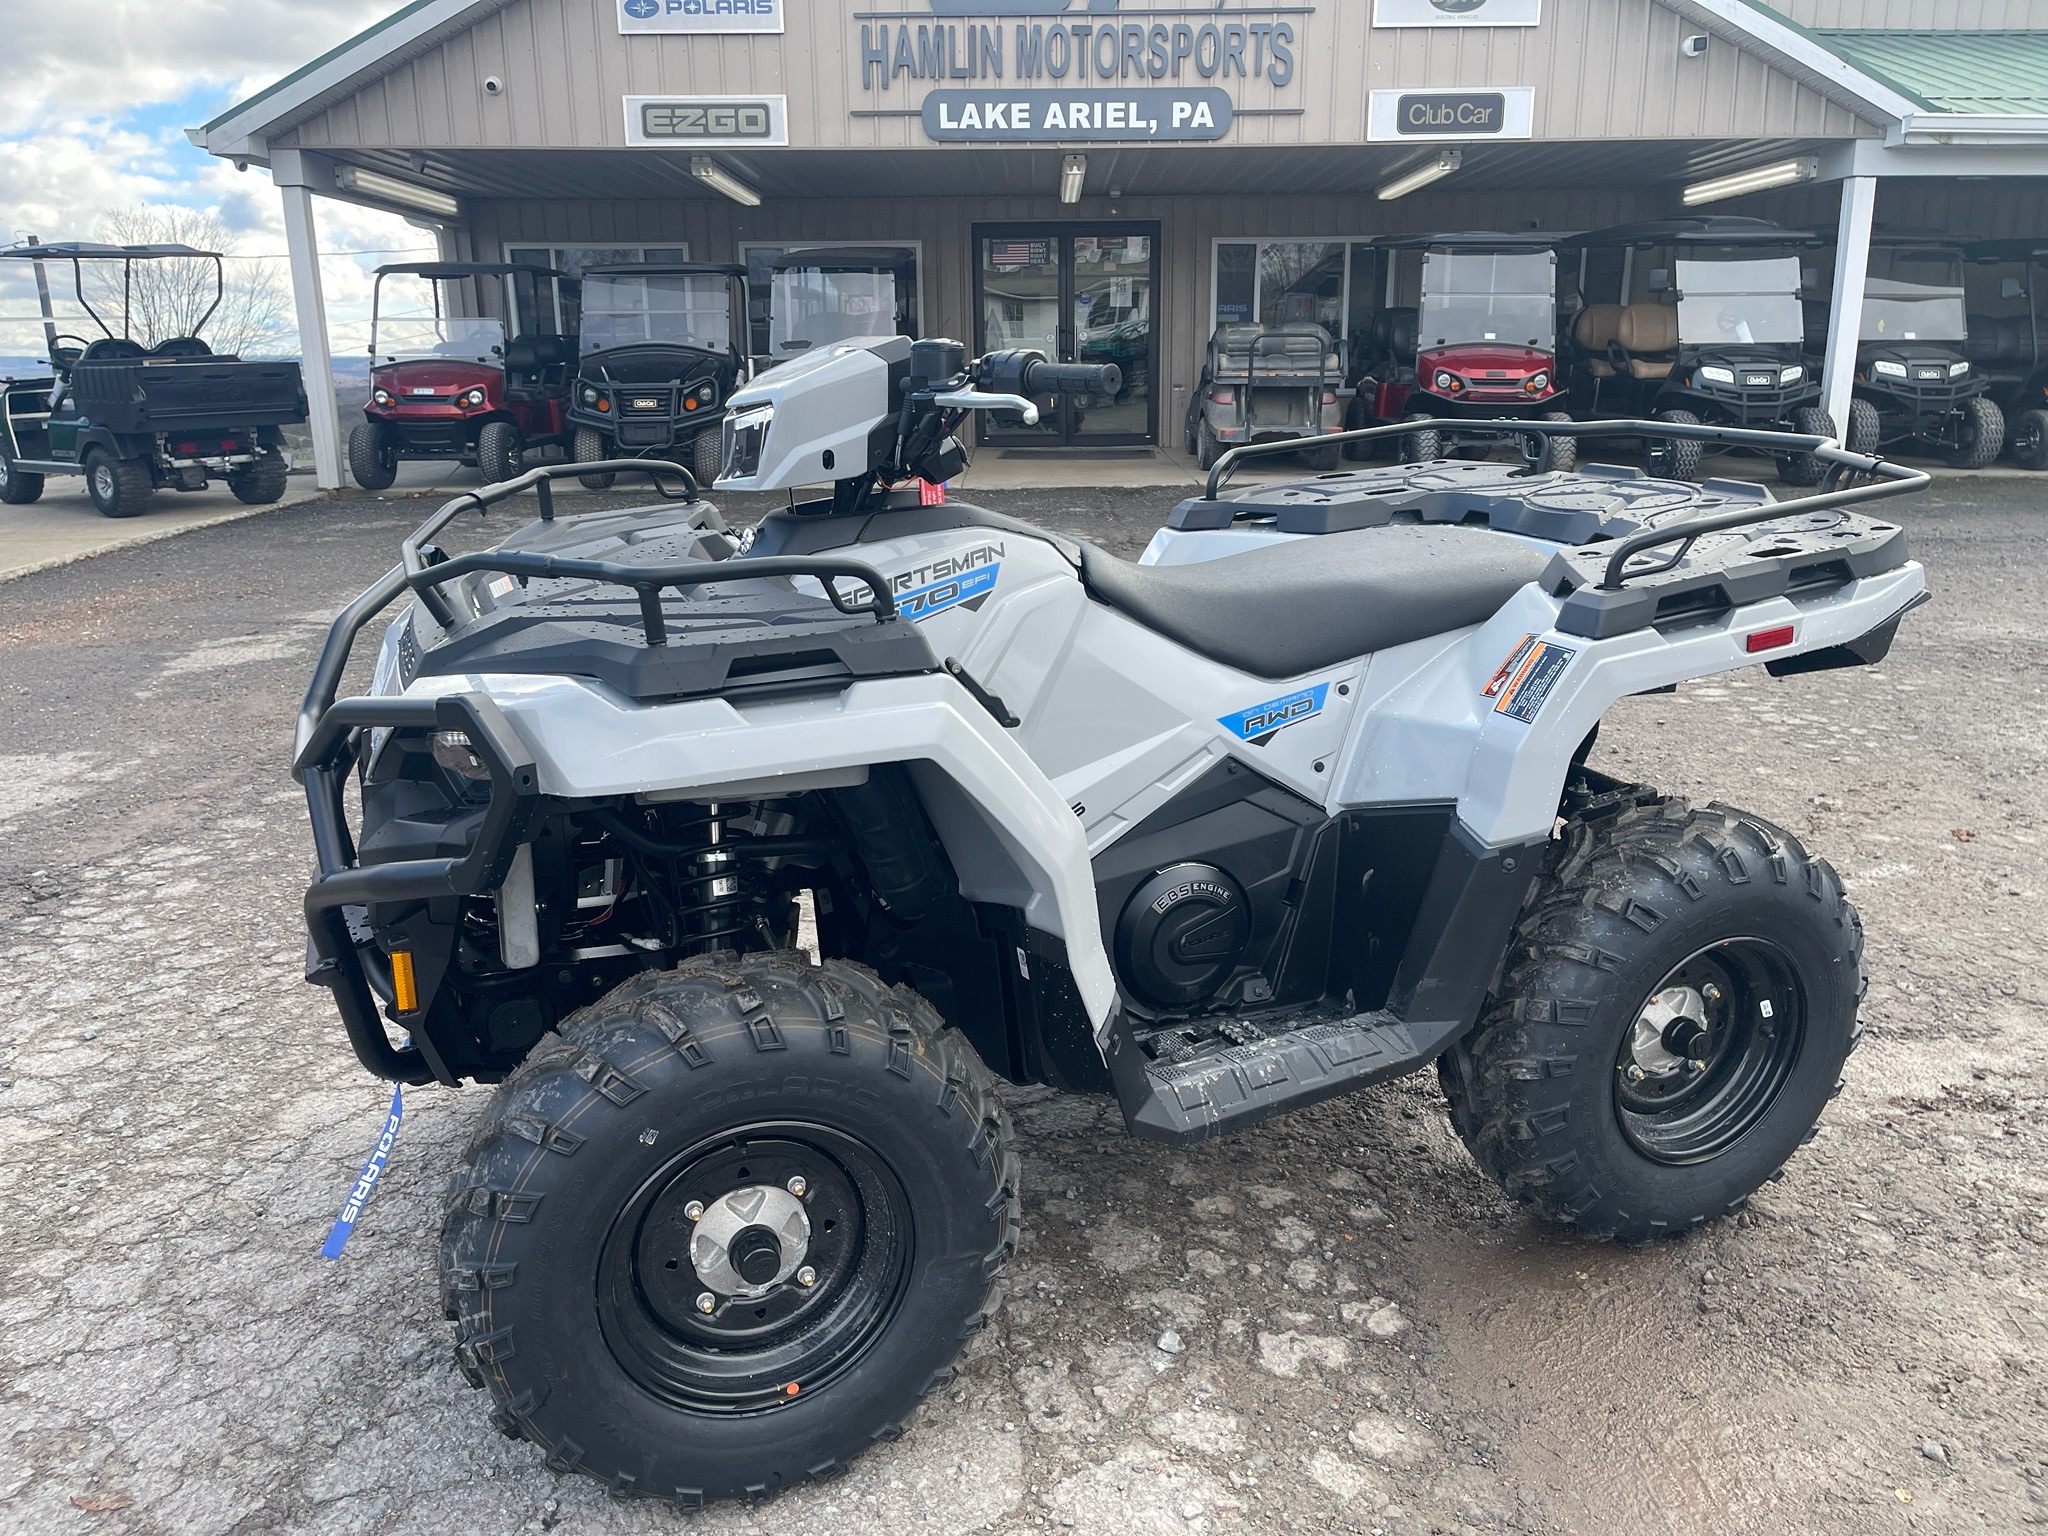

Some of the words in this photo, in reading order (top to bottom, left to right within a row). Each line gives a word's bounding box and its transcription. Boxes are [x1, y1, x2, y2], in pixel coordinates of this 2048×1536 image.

[666, 0, 774, 15] POLARIS
[861, 24, 1003, 90] HAMLIN
[1016, 21, 1295, 87] MOTORSPORTS
[939, 102, 1031, 130] LAKE
[1043, 101, 1158, 135] ARIEL,
[1172, 101, 1216, 129] PA
[1408, 103, 1454, 125] Club
[1456, 102, 1493, 124] Car
[1217, 304, 1248, 312] ARIS
[839, 542, 1006, 605] SPRTSMAN
[962, 573, 990, 590] EFI
[1511, 659, 1535, 688] WARNING
[1244, 698, 1315, 735] AWD
[1156, 884, 1191, 911] EBS
[1193, 882, 1231, 899] ENGINE
[692, 1075, 882, 1114] POLARIS
[341, 1114, 400, 1224] POLARIS
